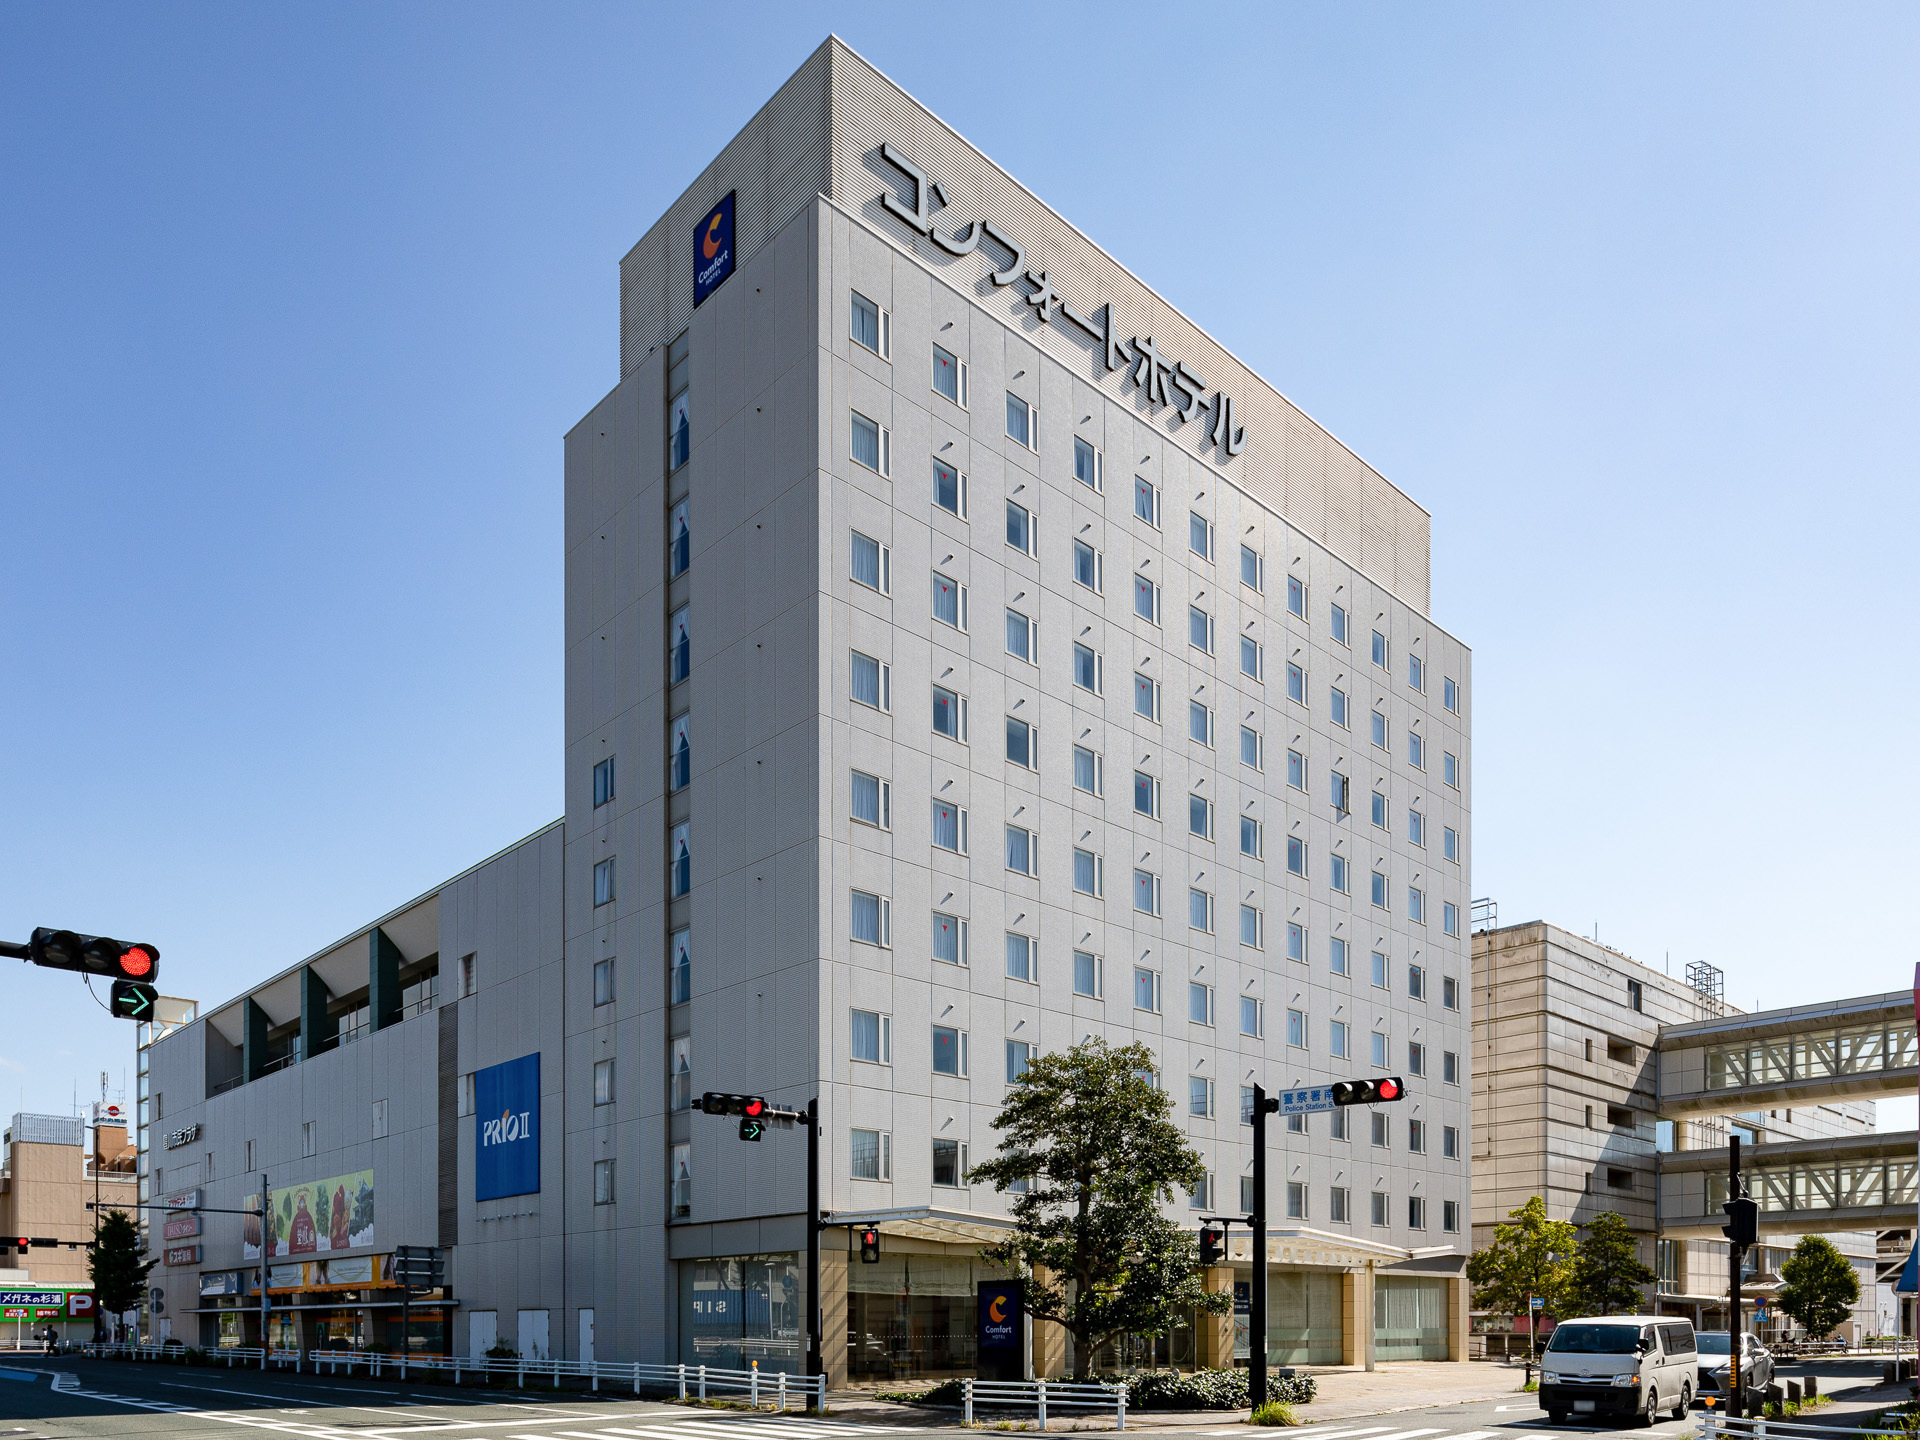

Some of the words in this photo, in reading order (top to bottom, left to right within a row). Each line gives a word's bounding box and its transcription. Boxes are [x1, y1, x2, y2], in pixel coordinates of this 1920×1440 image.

[698, 249, 728, 284] Comfort
[705, 267, 721, 286] HOTEL
[881, 142, 1248, 456] コンフォートホテル
[1284, 1088, 1333, 1104] 警察署南
[2, 1293, 62, 1304] メガネの杉浦
[69, 1294, 93, 1316] P
[985, 1325, 1012, 1333] Comfort
